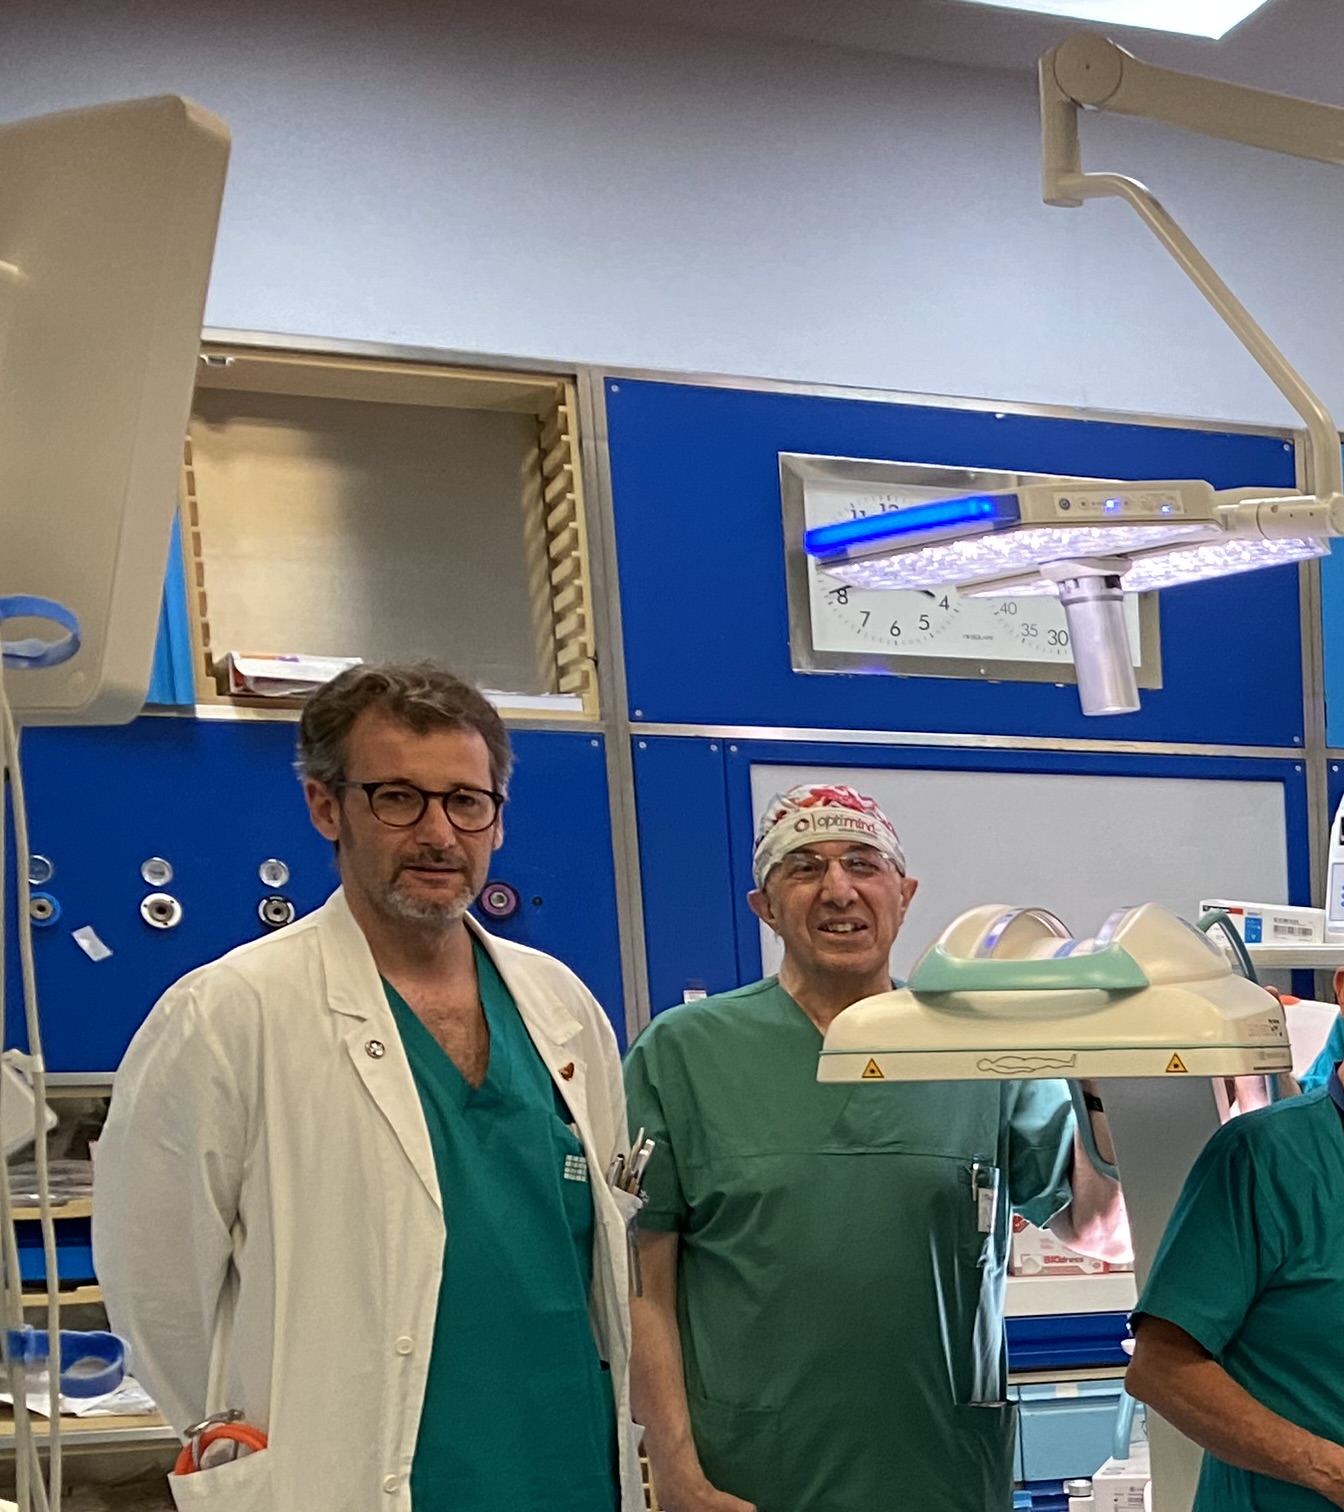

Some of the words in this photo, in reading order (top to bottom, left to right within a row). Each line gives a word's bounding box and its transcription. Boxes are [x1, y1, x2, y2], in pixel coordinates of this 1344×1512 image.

[837, 588, 849, 606] 8
[939, 595, 950, 611] 4
[1000, 602, 1018, 616] 40
[859, 611, 871, 628] 7
[918, 614, 931, 631] 5
[889, 621, 902, 637] 6
[1021, 623, 1039, 638] 35
[1047, 630, 1069, 647] 30
